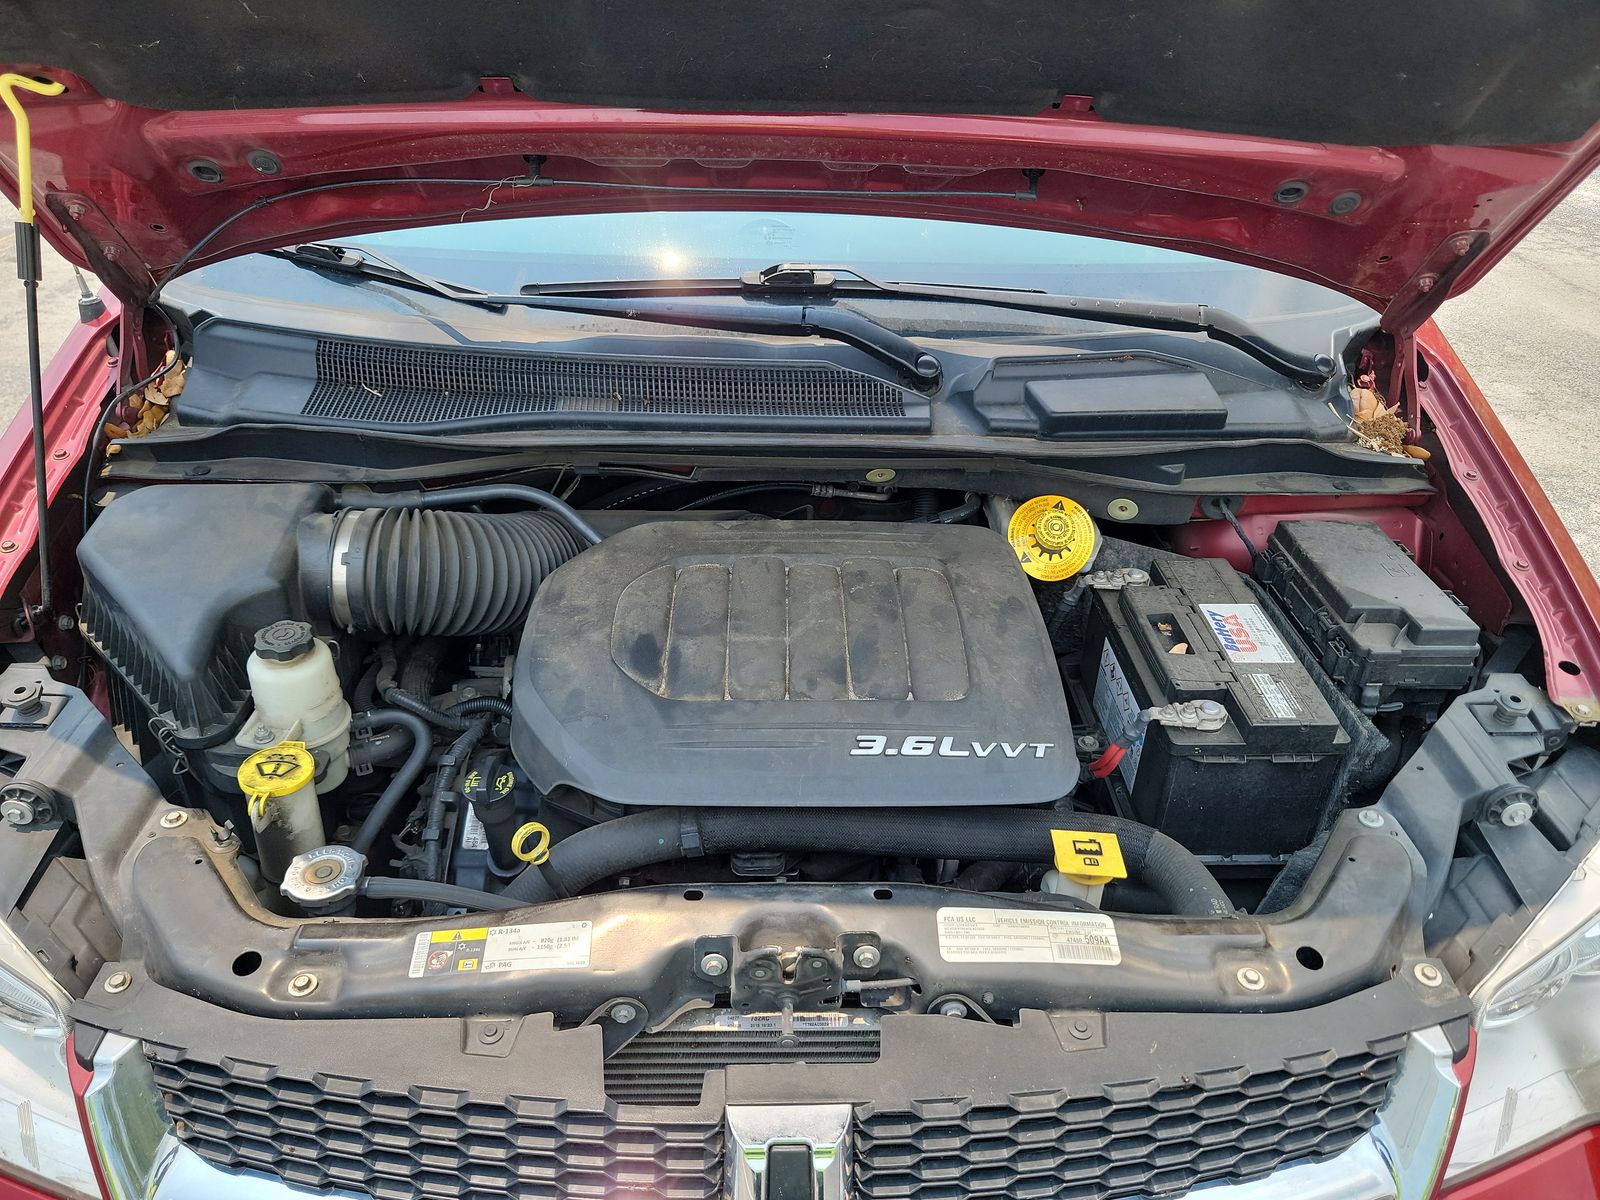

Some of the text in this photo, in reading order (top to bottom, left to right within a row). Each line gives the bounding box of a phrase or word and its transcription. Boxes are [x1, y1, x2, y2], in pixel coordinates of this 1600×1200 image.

[1206, 609, 1241, 653] Battery
[1222, 613, 1259, 653] USA
[849, 735, 1055, 758] 3.6L VVT
[498, 927, 521, 935] R-134a
[996, 917, 1020, 925] VEHICLE
[1020, 918, 1046, 926] EMISSION
[1046, 919, 1070, 927] CONTROL
[1071, 920, 1107, 929] INFORMATION
[1084, 934, 1111, 945] 509AA
